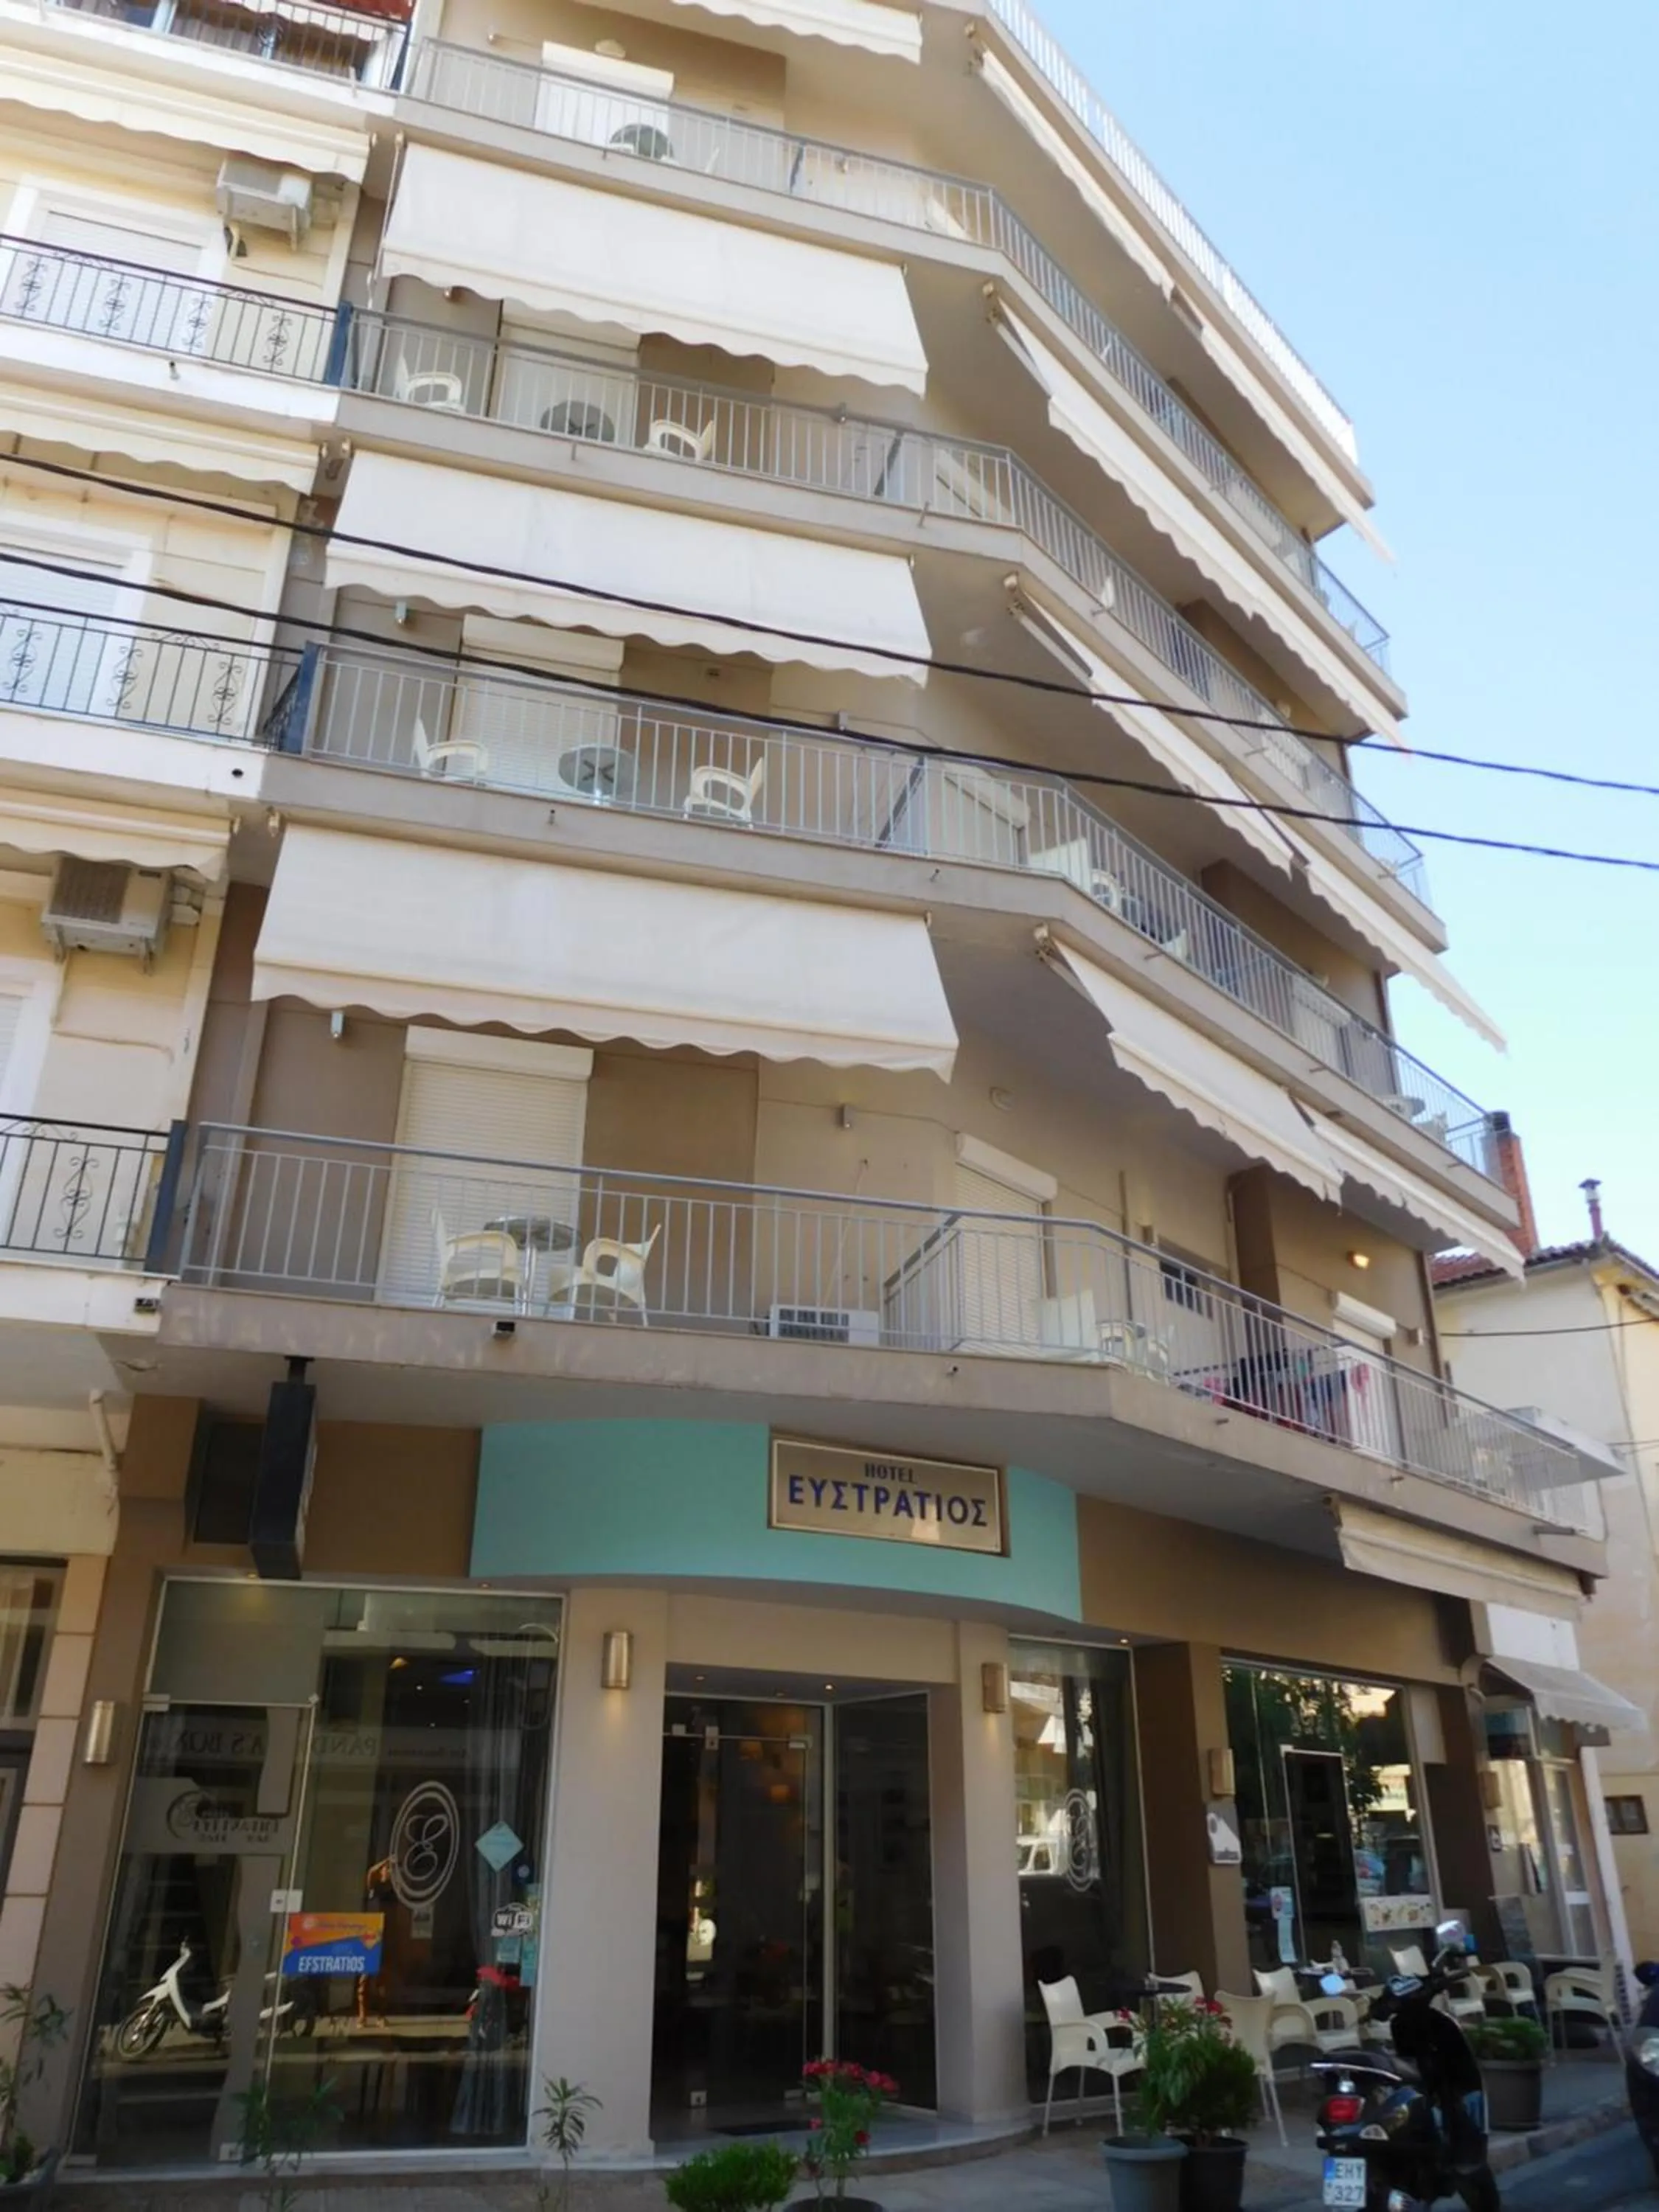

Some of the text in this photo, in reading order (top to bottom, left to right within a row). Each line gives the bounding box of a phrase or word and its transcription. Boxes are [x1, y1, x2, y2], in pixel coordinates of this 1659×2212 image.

[863, 1461, 917, 1484] HOTEL
[788, 1474, 988, 1527] ΕΥΣΤΡΑΤΙΟΣ
[298, 1955, 366, 1972] EFSTRATIOS
